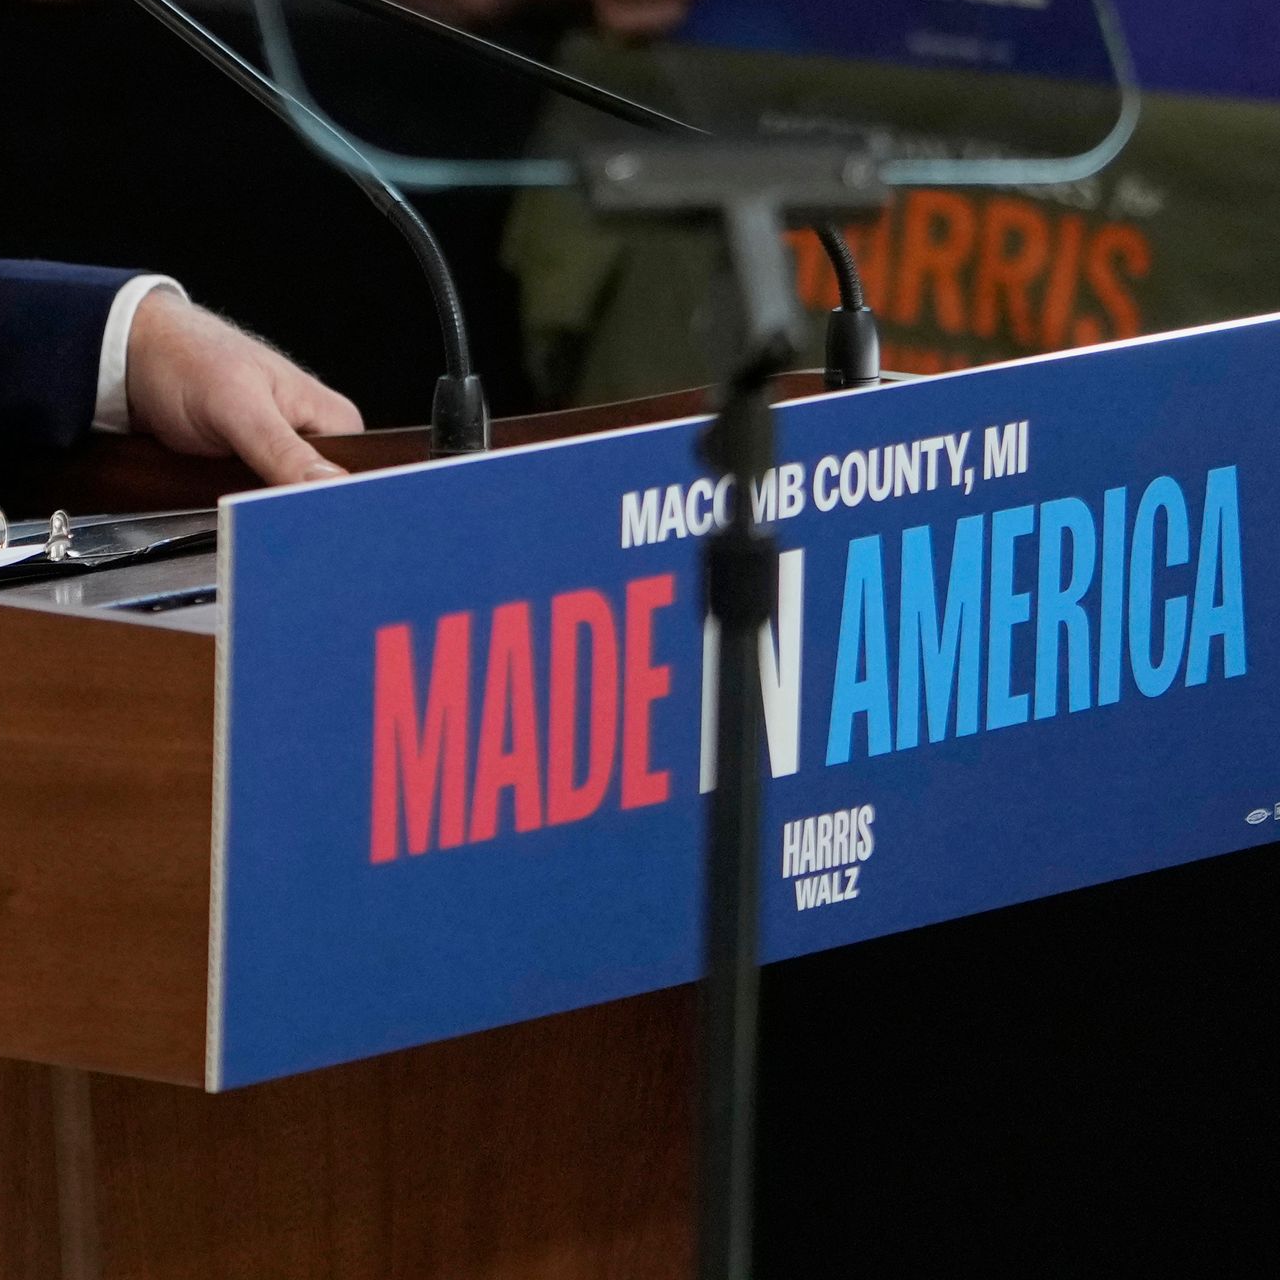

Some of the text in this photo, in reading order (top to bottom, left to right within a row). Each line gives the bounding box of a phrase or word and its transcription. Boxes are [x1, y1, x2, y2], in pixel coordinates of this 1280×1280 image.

[812, 430, 975, 497] COUNTY,
[982, 419, 1030, 482] MI
[367, 573, 676, 865] MADE
[825, 464, 1247, 768] AMERICA
[782, 803, 876, 880] HARRIS
[794, 866, 861, 912] WALZ
